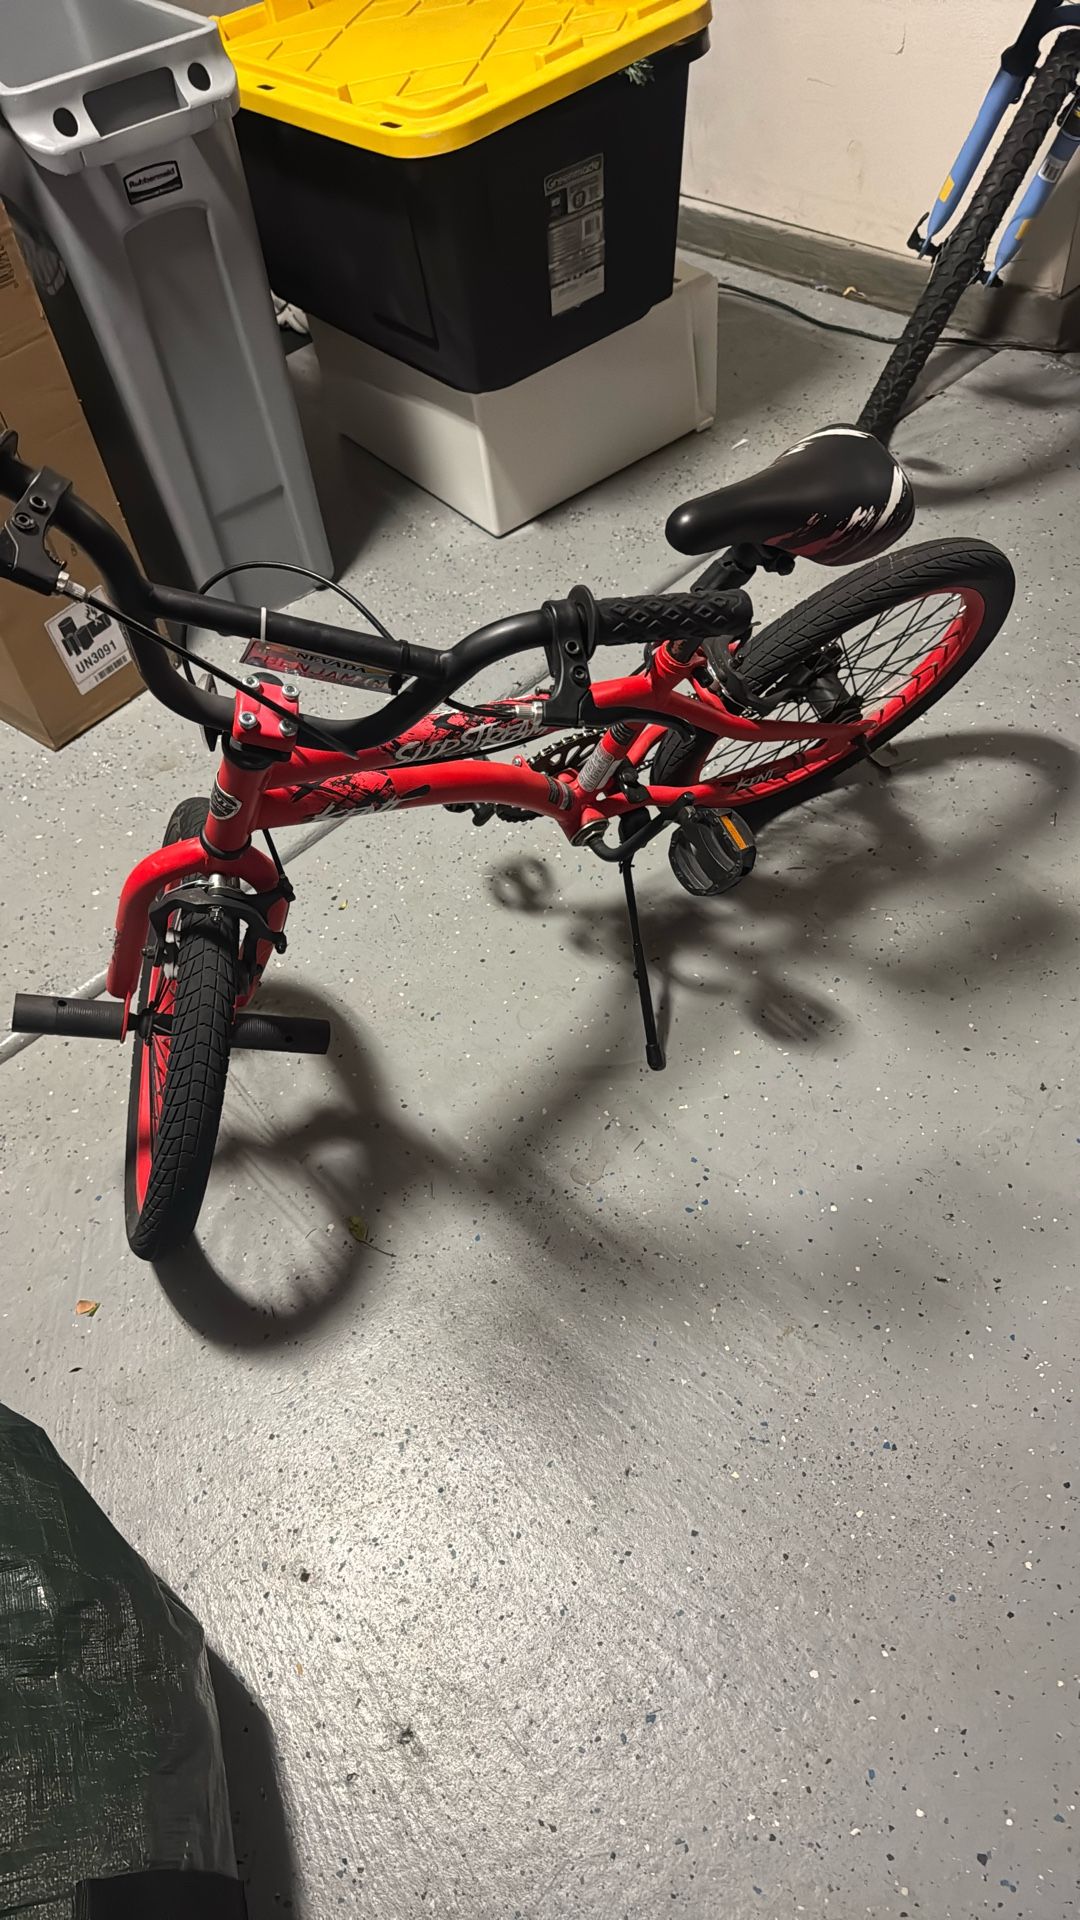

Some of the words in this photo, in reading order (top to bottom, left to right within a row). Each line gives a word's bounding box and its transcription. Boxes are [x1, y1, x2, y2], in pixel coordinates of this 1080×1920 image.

[129, 167, 175, 189] Rubbermaid
[75, 639, 117, 674] UN3091
[295, 651, 367, 674] NEVADA
[733, 768, 780, 792] KENT
